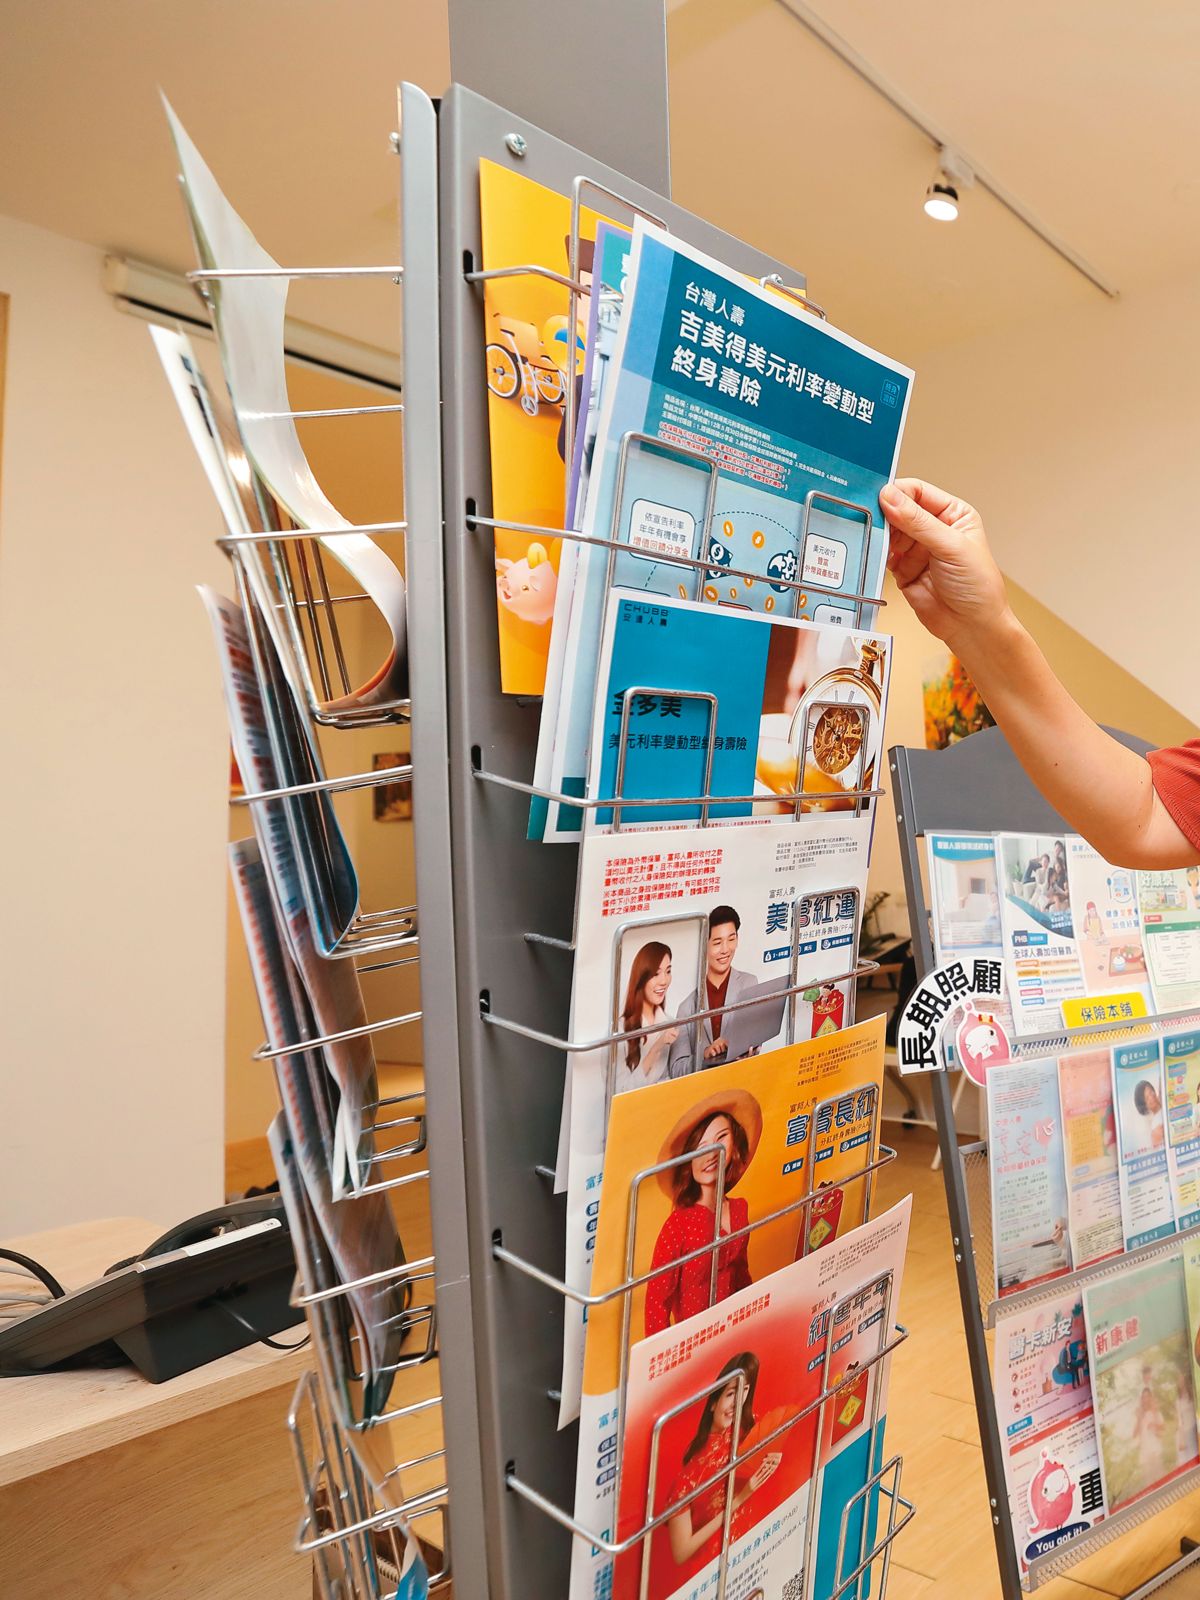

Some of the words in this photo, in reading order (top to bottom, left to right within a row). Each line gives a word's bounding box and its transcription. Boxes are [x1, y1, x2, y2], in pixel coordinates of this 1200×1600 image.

[684, 281, 746, 328] 台灣人壽
[669, 345, 763, 408] 終身壽險
[679, 308, 875, 425] 吉美得美元利率變動型
[624, 603, 669, 617] CHUBB
[769, 886, 796, 899] 富邦人壽
[901, 959, 1001, 1069] 長期照顧
[1094, 1316, 1139, 1355] 新康健
[1036, 1538, 1055, 1554] You
